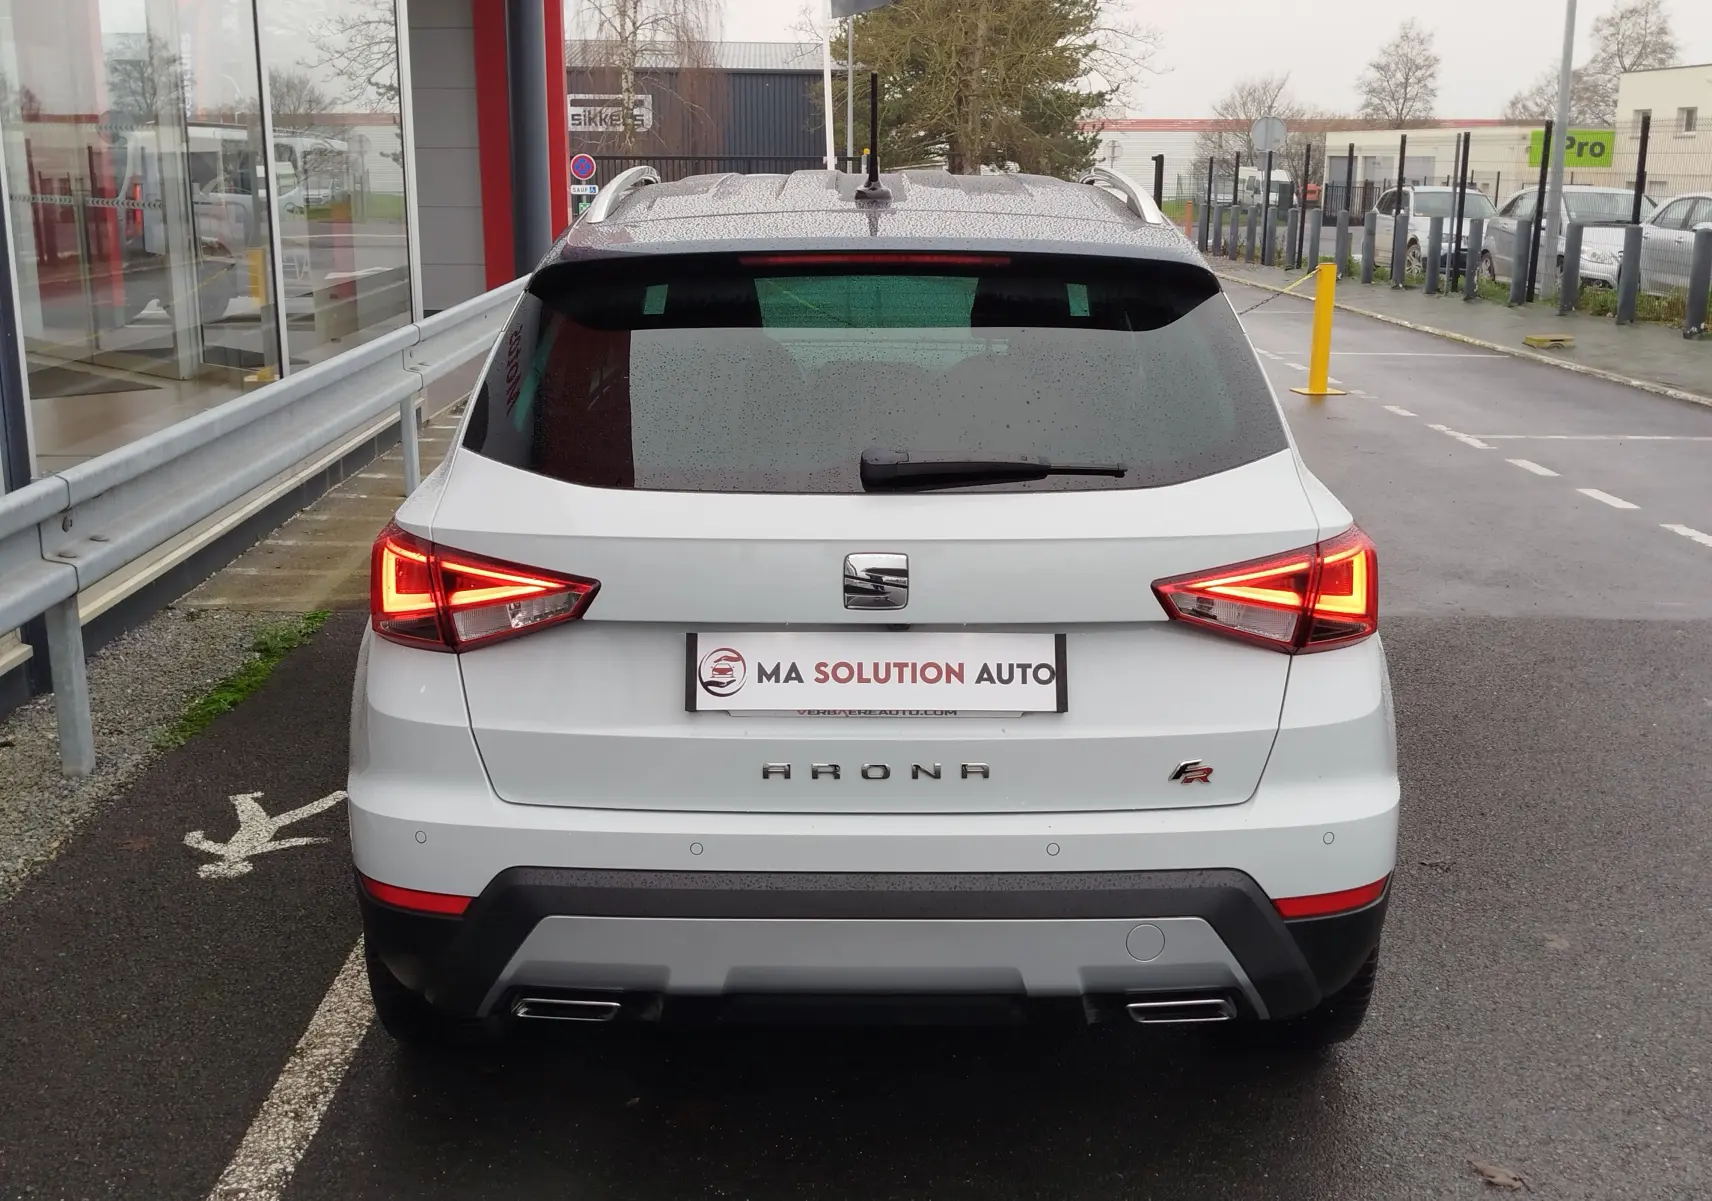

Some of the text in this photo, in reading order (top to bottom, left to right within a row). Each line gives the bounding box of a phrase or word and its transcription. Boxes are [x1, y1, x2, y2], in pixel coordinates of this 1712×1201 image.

[571, 109, 645, 126] sikkes
[757, 661, 1057, 685] MA SOLUTION AUTO
[761, 762, 990, 781] ARONA
[1168, 758, 1214, 785] FR
